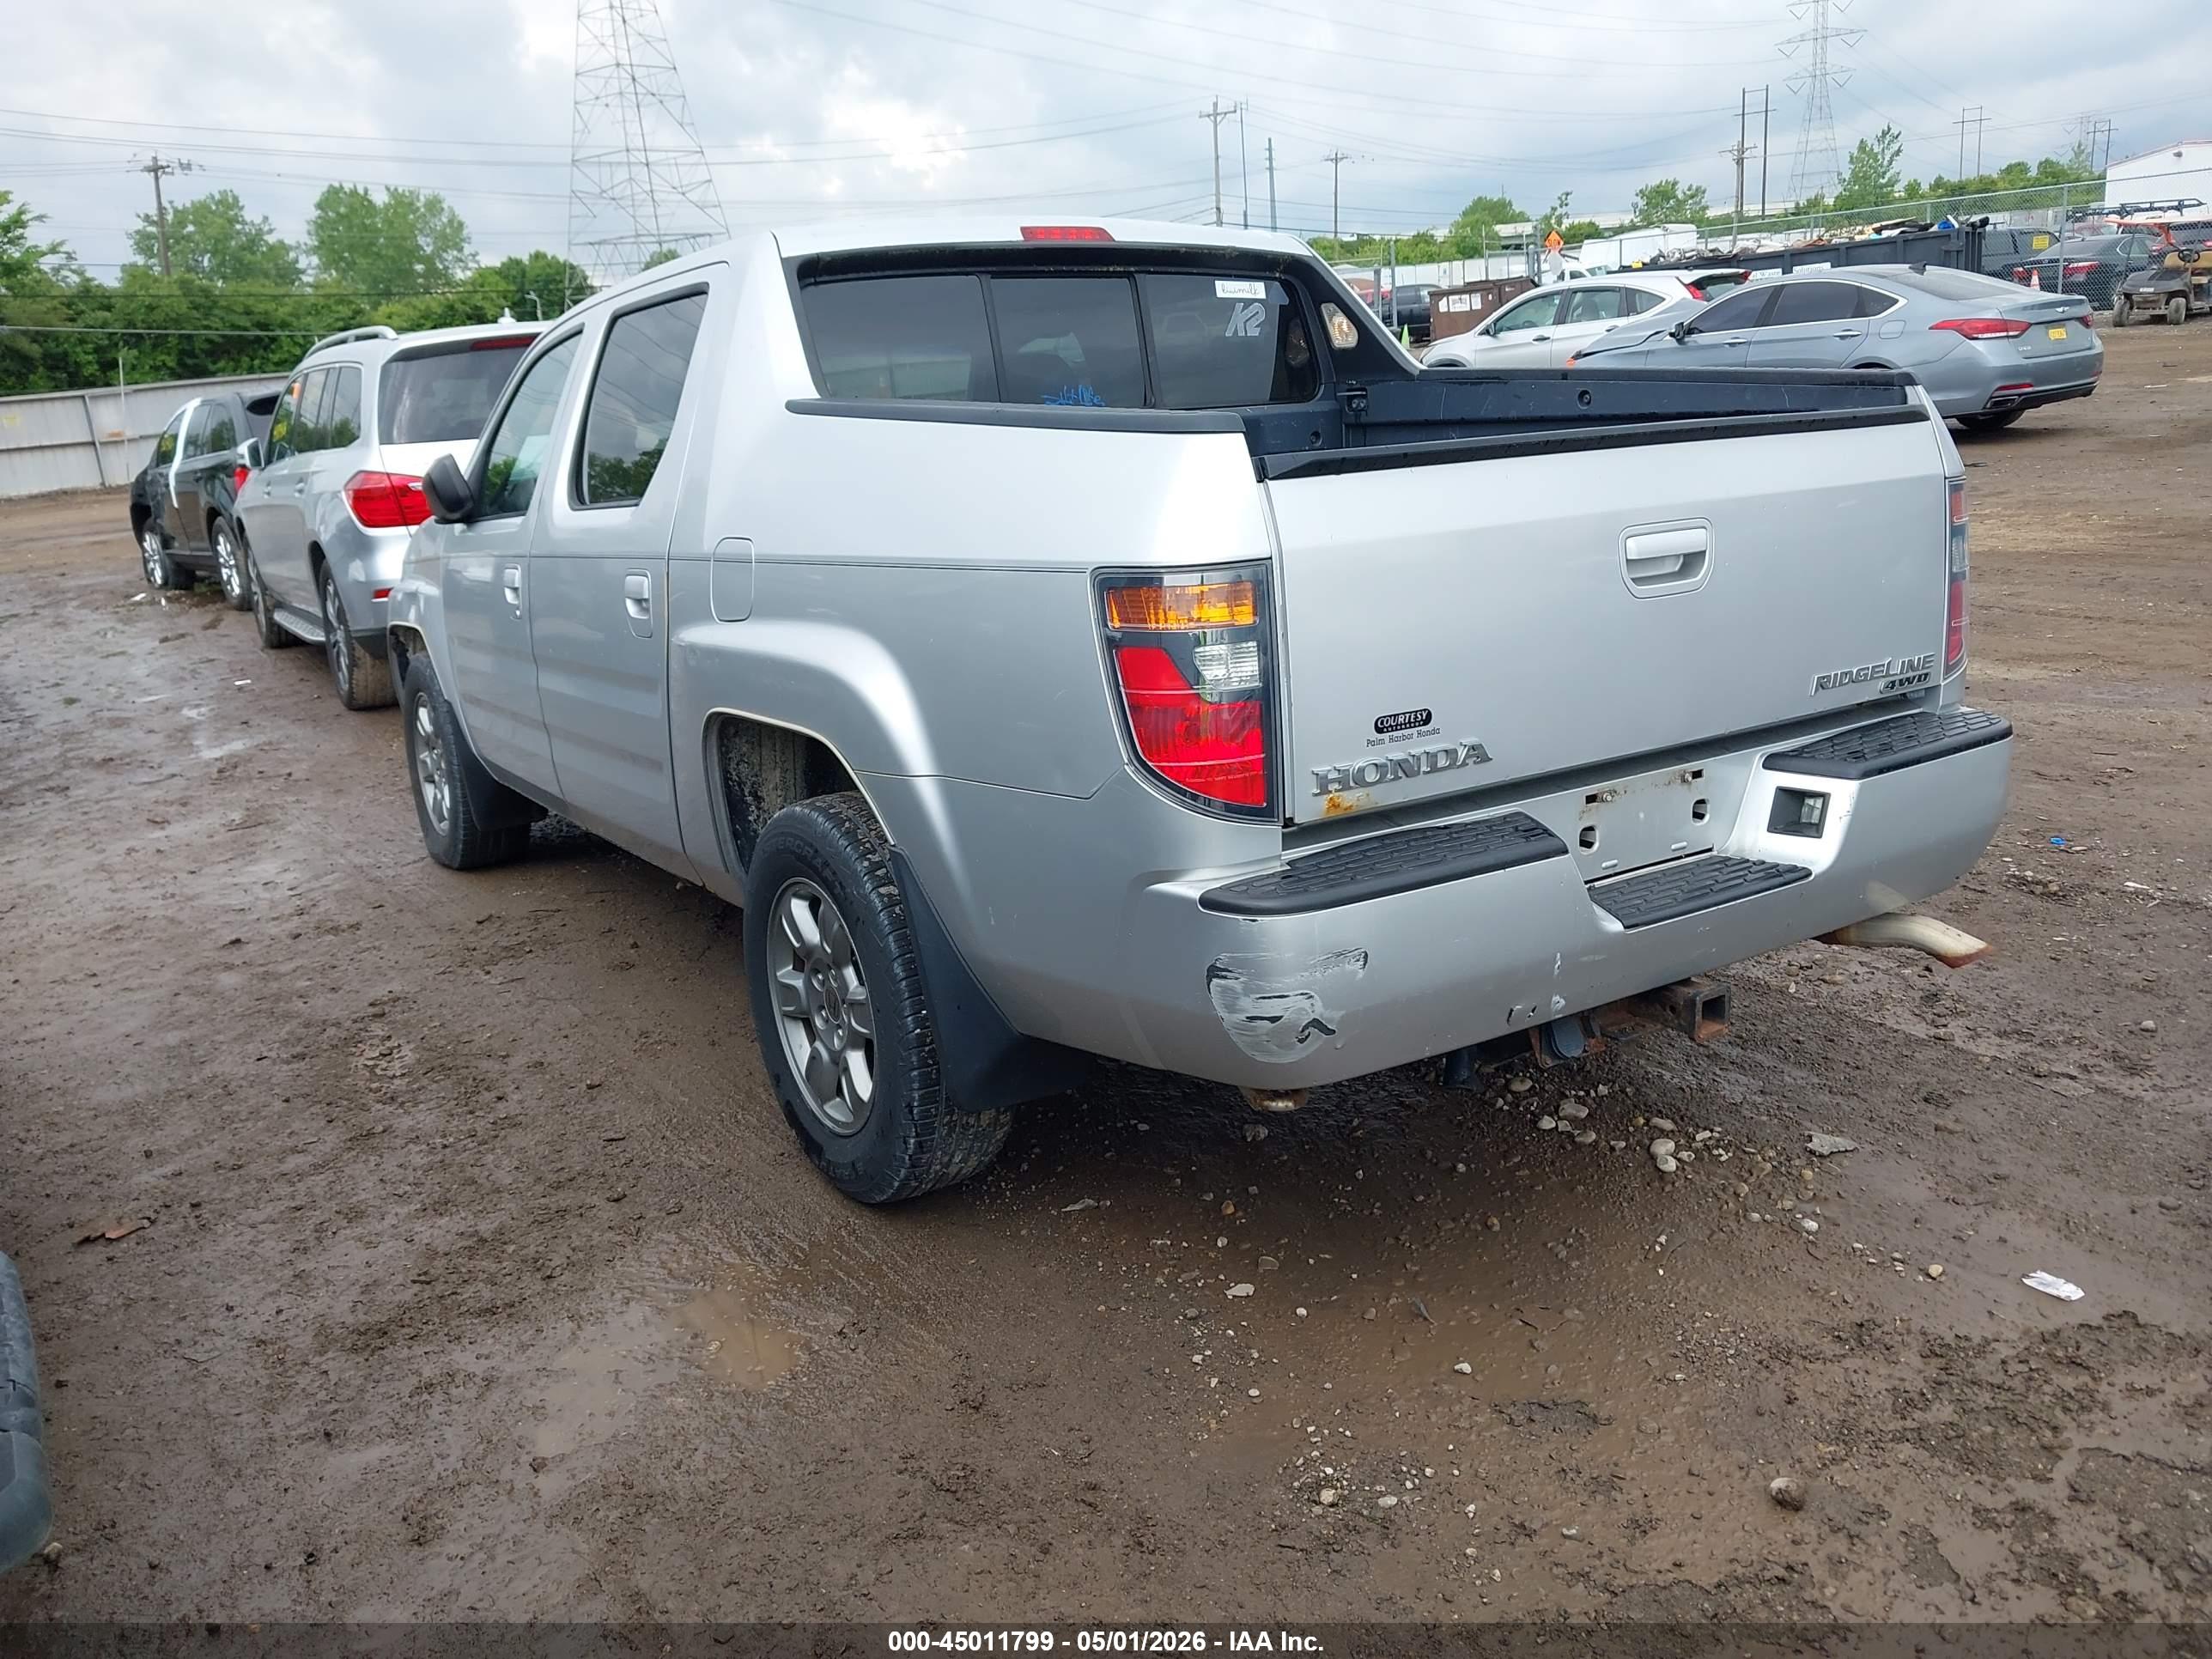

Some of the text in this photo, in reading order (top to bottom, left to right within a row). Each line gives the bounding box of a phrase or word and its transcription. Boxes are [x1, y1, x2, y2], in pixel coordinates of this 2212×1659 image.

[1225, 302, 1266, 337] K2
[1808, 652, 1936, 696] RIDGELINE
[1881, 672, 1930, 693] 4WD
[1376, 709, 1429, 728] COURTESY
[1365, 726, 1441, 748] Palm Harbor Honda
[1310, 737, 1493, 797] HONDA
